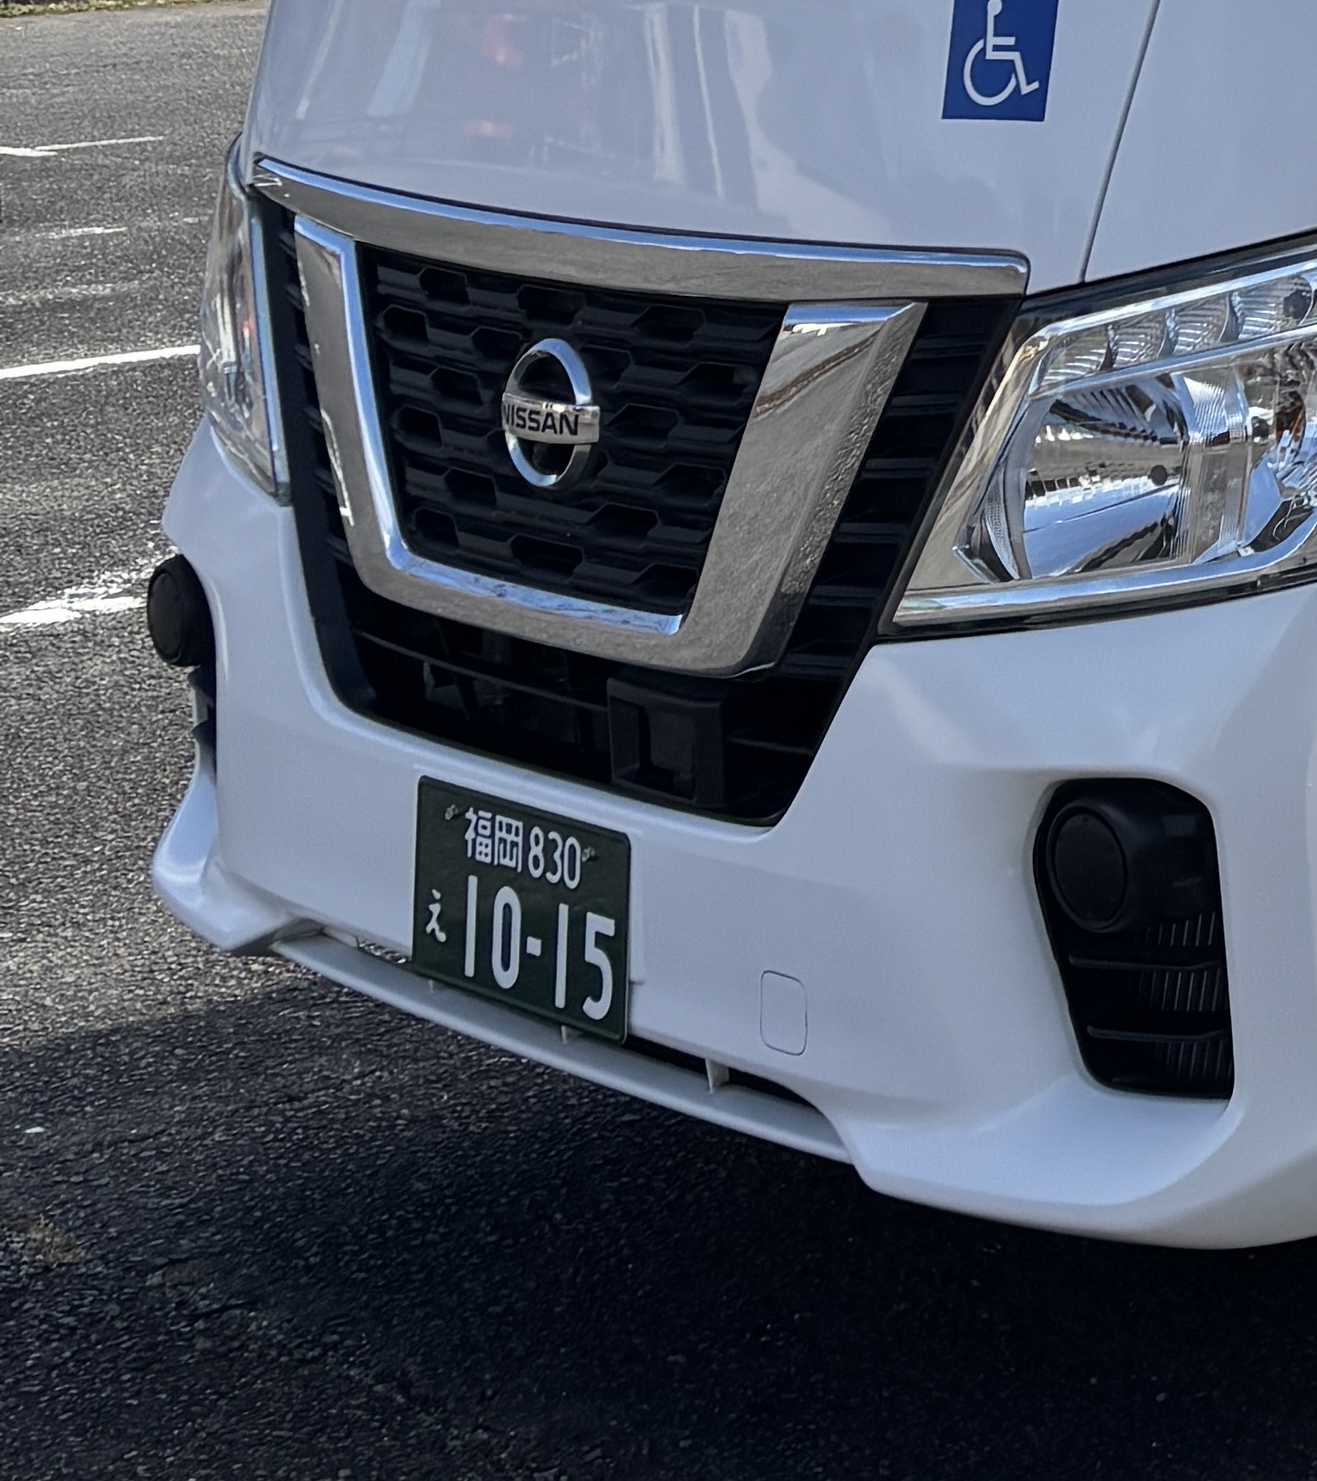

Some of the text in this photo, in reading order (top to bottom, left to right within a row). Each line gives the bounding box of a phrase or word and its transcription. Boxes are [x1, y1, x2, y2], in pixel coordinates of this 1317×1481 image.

[502, 402, 580, 436] NISSAN
[464, 806, 582, 890] 福岡 830
[425, 874, 616, 1020] え 10-15
